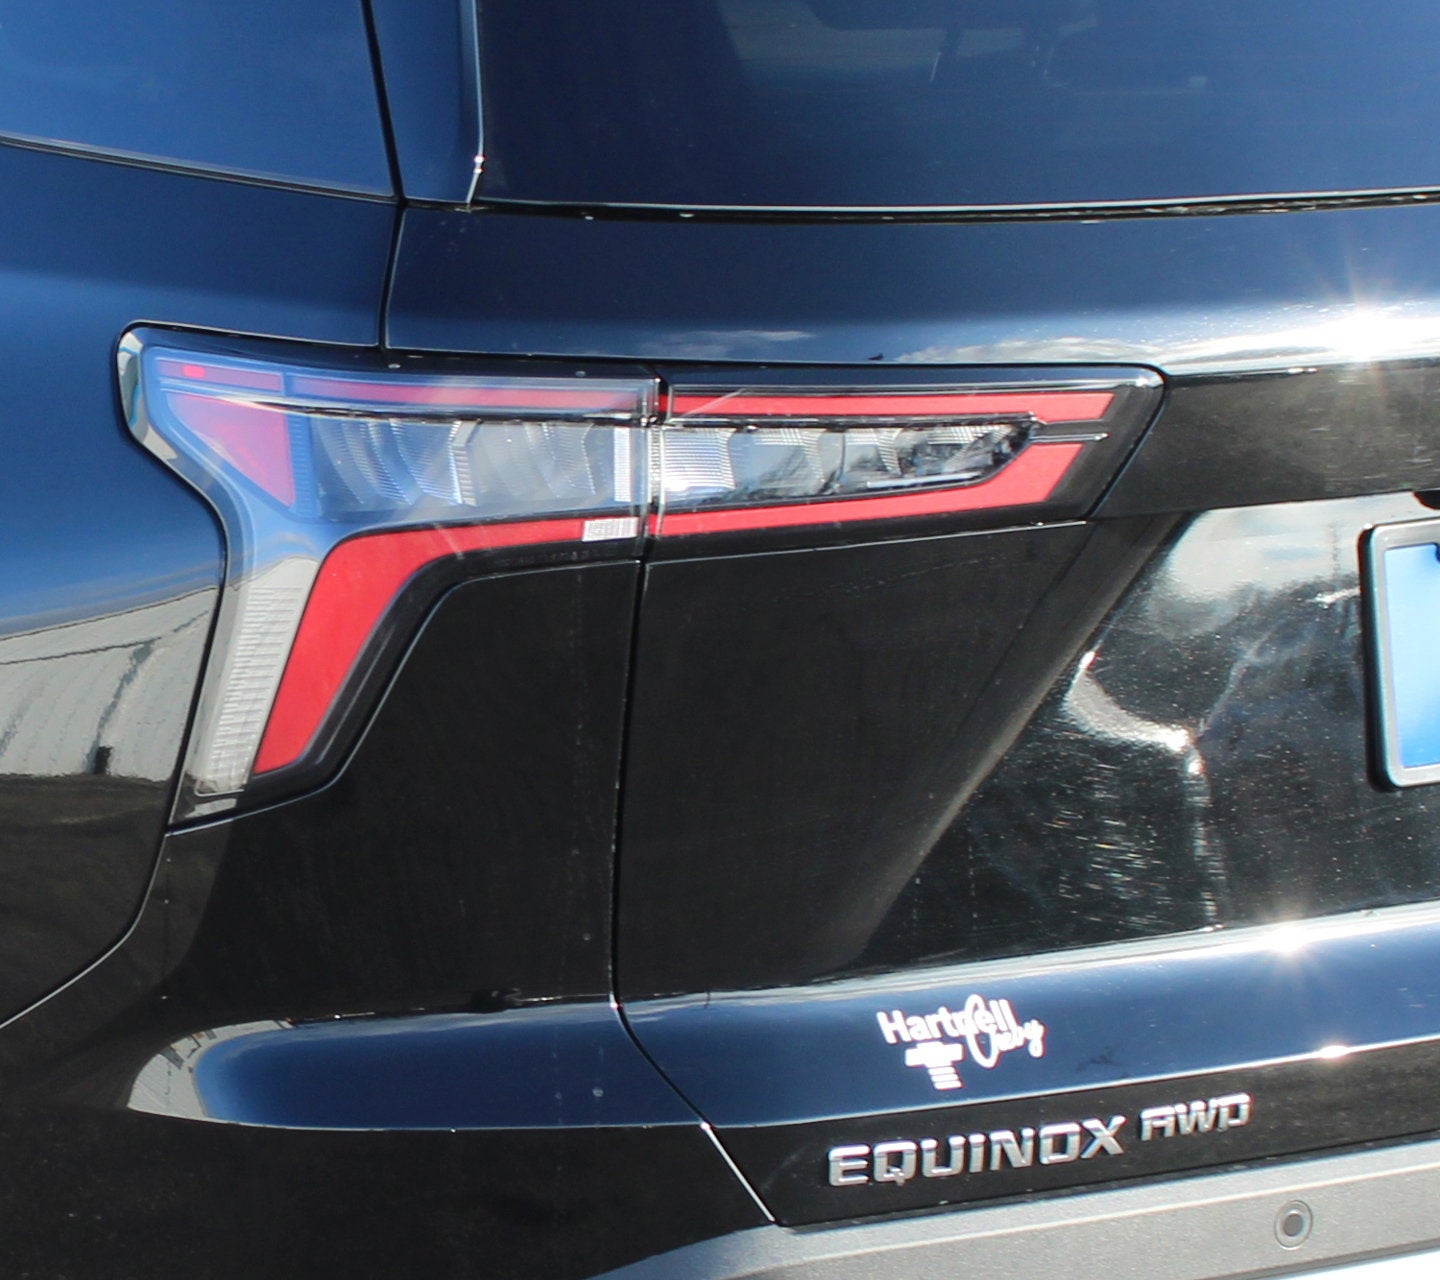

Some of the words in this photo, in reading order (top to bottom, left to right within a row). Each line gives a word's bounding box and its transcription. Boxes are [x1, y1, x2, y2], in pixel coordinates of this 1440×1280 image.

[876, 998, 1017, 1044] Hartnell
[827, 1114, 1128, 1188] EQUINOX
[1139, 1091, 1253, 1142] AWD
